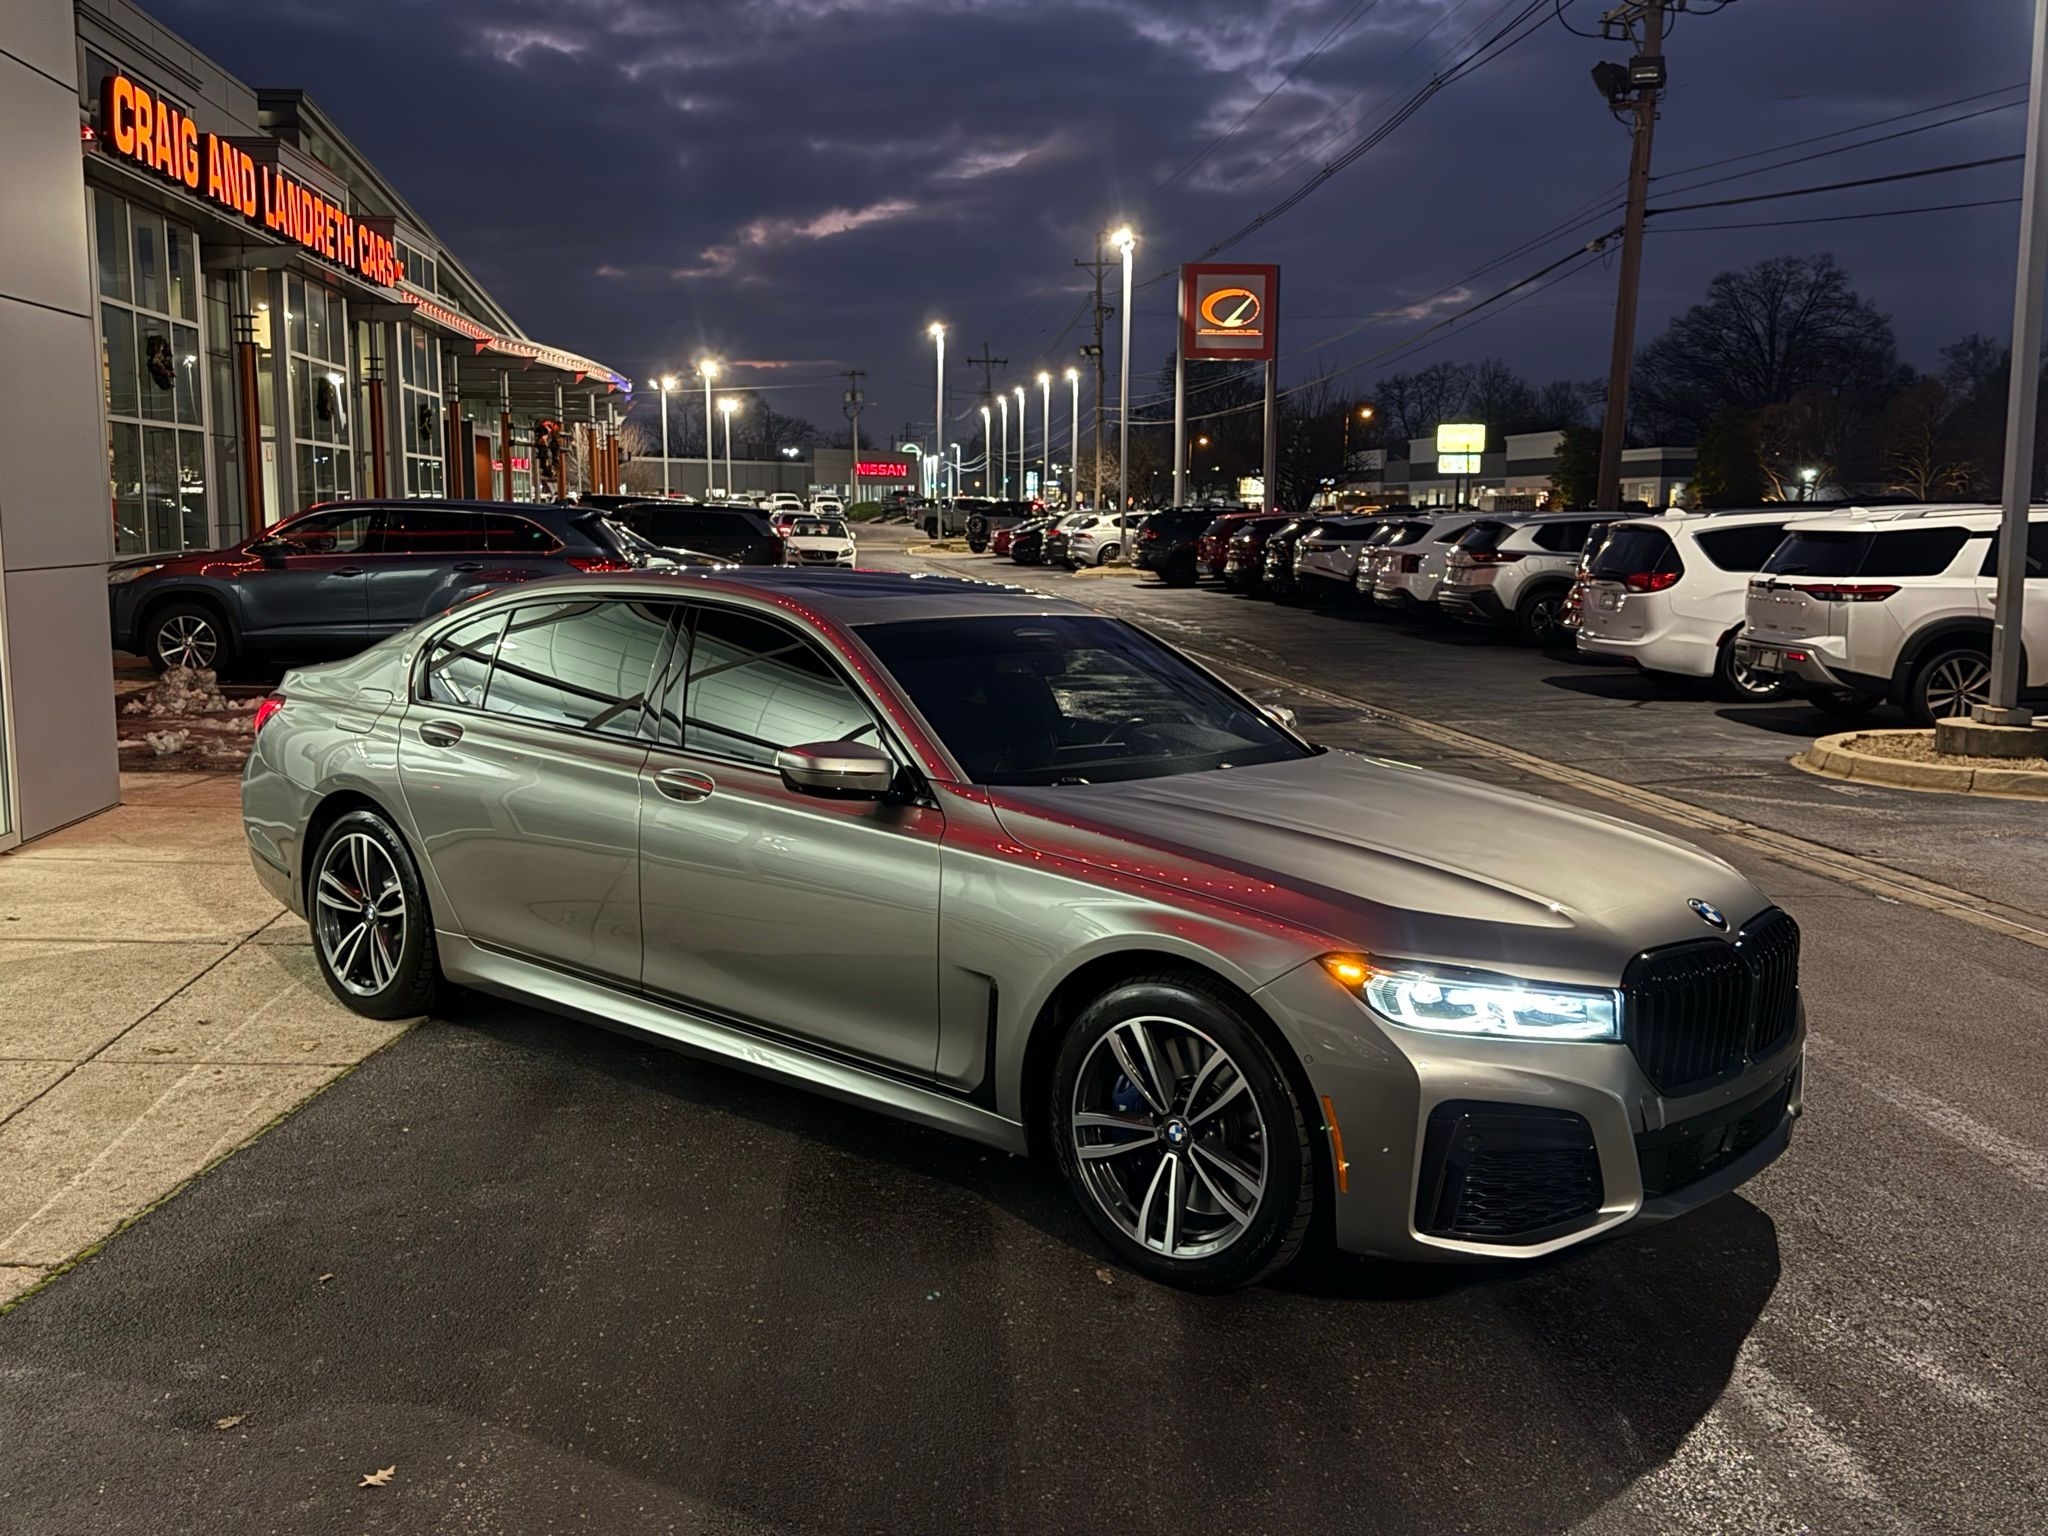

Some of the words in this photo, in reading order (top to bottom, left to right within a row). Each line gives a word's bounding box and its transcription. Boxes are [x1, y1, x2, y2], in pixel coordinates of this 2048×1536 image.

[113, 75, 198, 188] CRAIG
[208, 132, 256, 217] AND
[263, 165, 355, 269] LANDRETH
[358, 224, 395, 288] CARS
[856, 463, 907, 476] NISSAN
